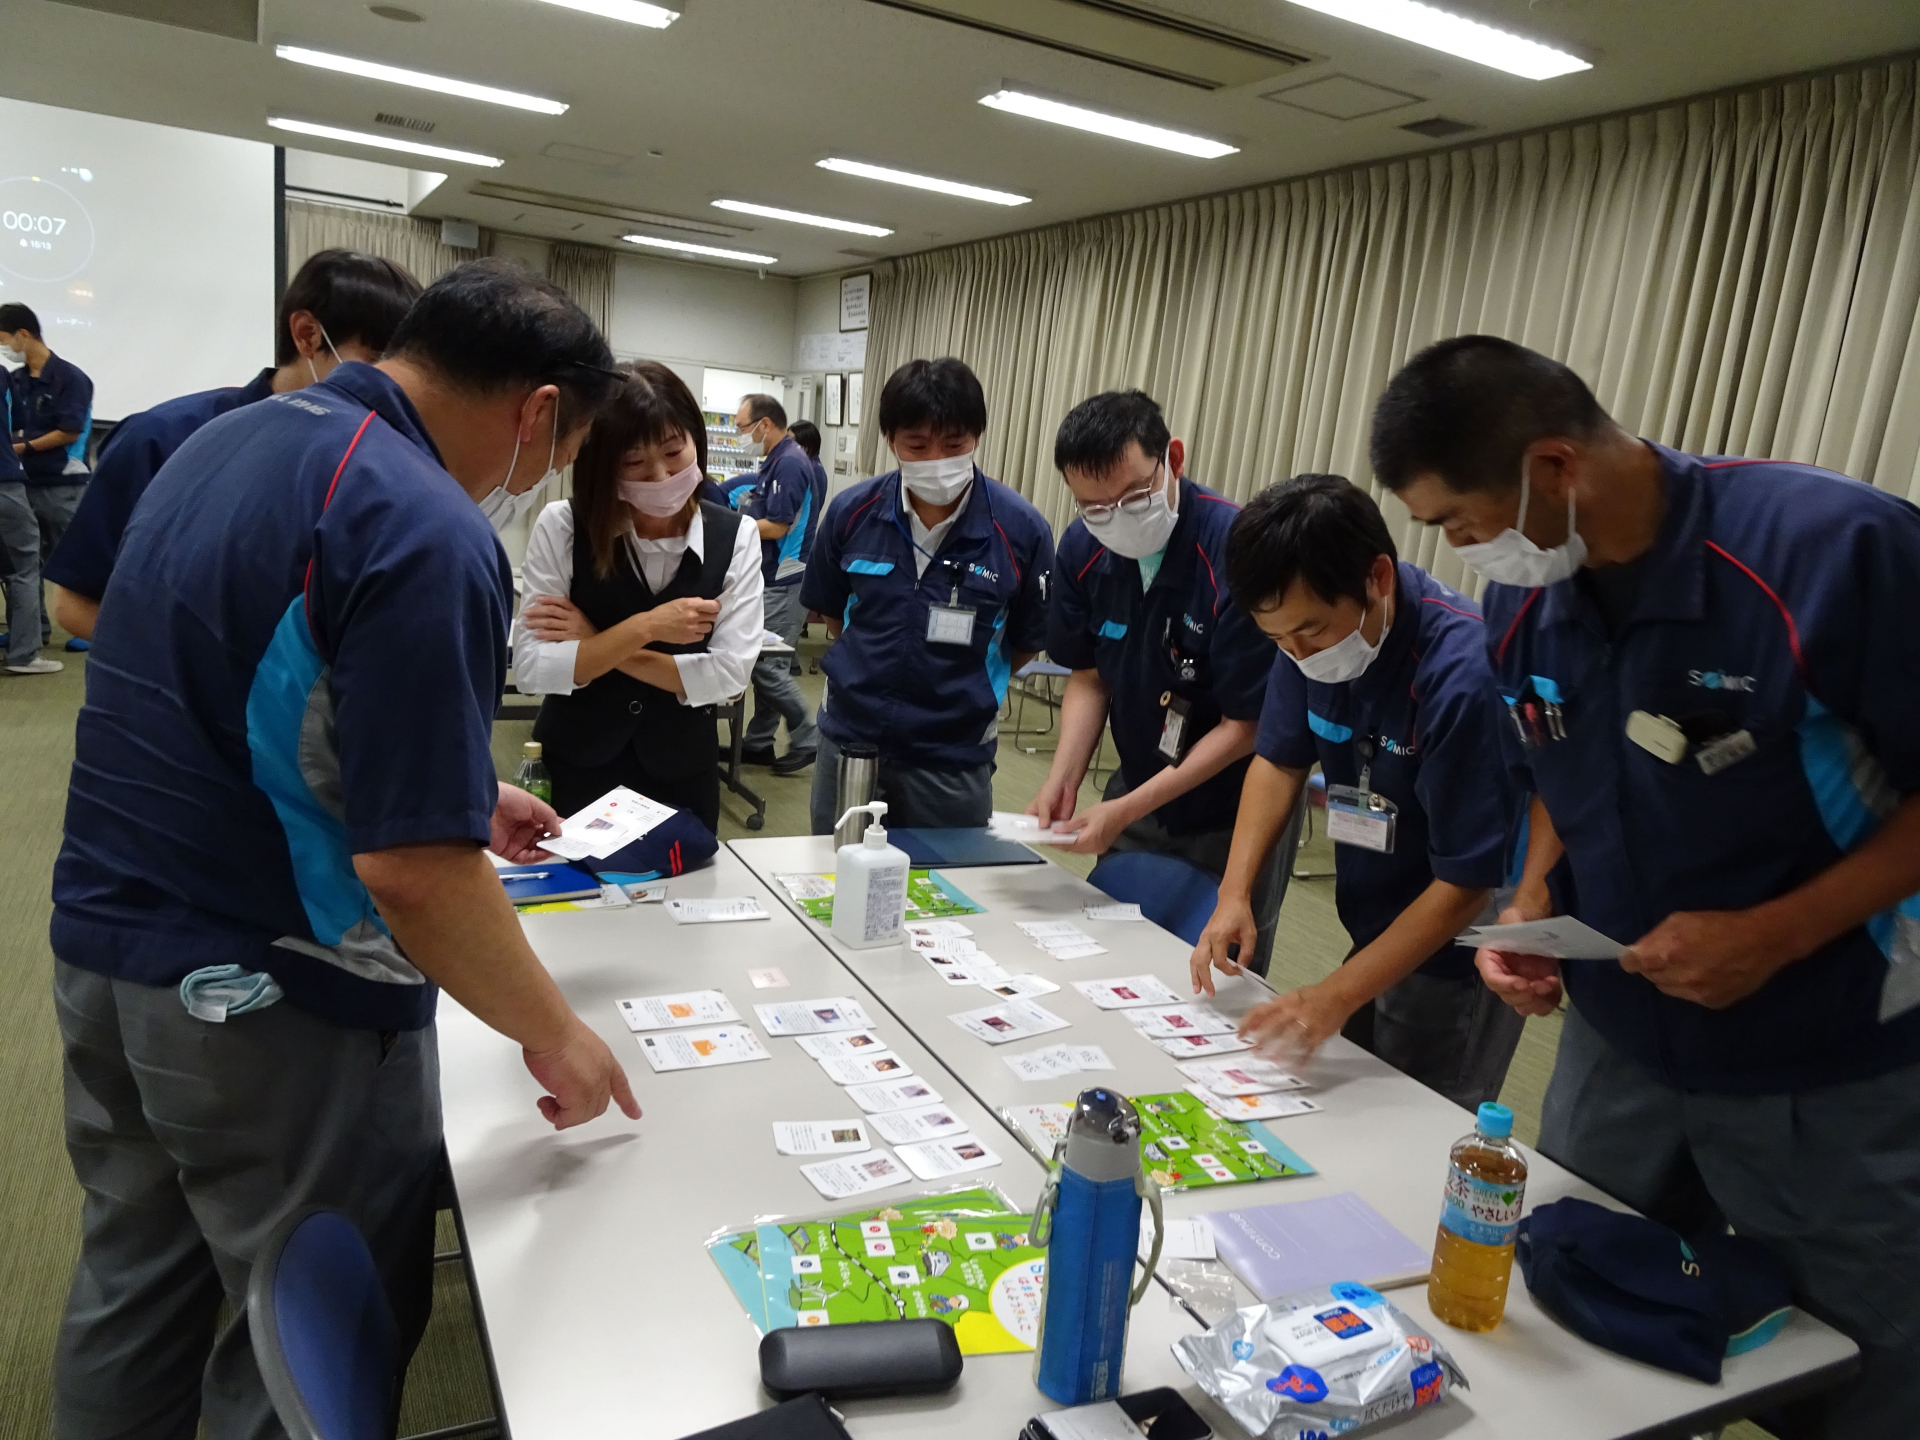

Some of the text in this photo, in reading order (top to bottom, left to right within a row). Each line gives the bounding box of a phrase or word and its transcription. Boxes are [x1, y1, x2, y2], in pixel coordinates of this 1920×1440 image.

[3, 210, 67, 236] 00:07
[968, 562, 999, 583] SOMIC
[1380, 735, 1416, 756] SOMIC
